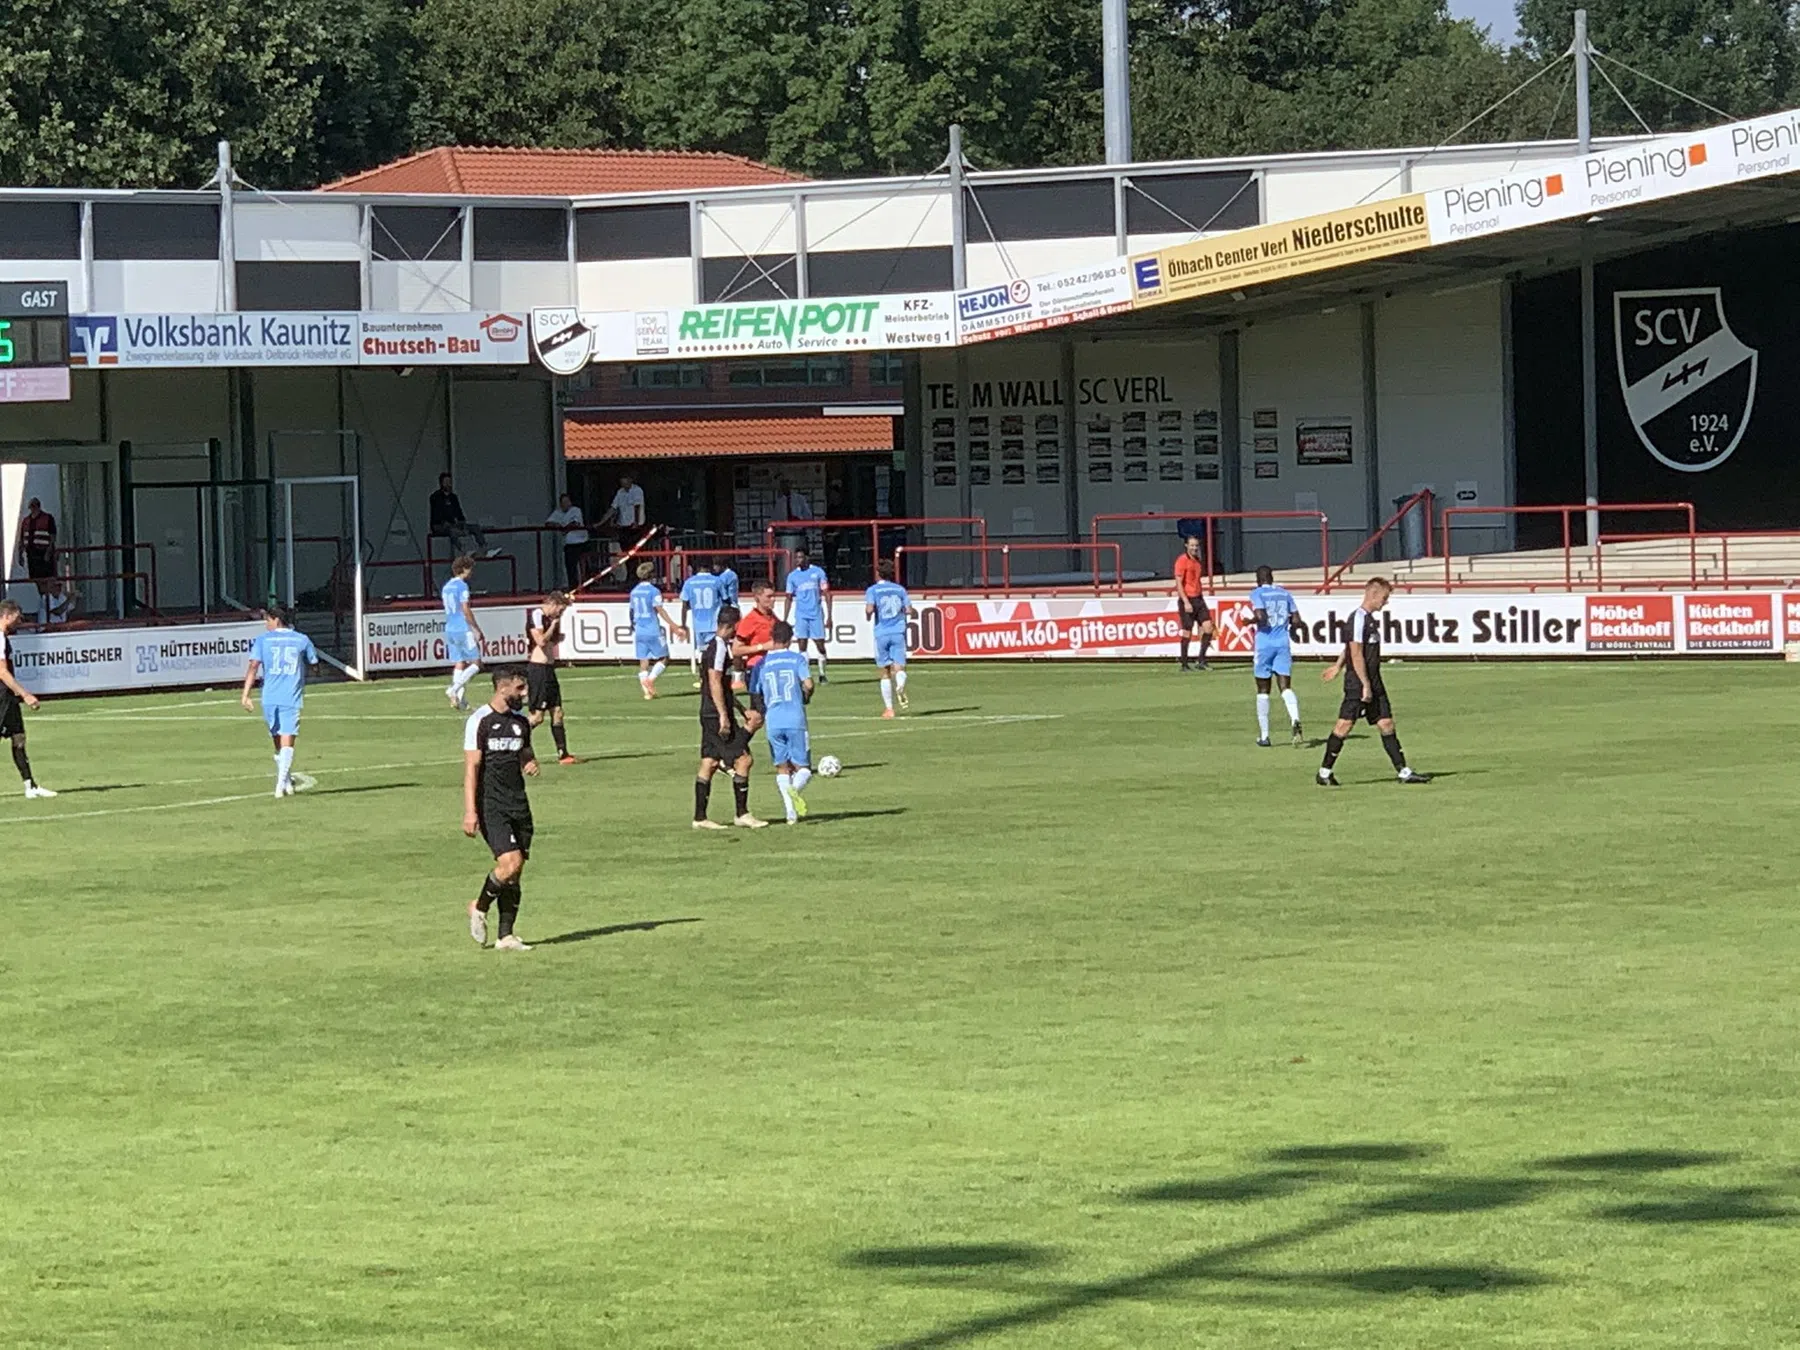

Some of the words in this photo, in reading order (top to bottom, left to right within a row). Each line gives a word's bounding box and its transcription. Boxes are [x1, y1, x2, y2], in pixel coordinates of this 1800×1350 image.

[1732, 116, 1800, 157] Pieni
[1585, 147, 1685, 188] Piening
[1737, 153, 1790, 175] Personal
[1445, 177, 1543, 218] Piening
[1591, 185, 1642, 207] Personal
[1450, 216, 1500, 235] Personal
[1168, 255, 1213, 278] Ölbach
[1215, 245, 1258, 268] Center
[1261, 238, 1288, 258] Verl
[1292, 205, 1425, 251] Niederschulte
[21, 290, 58, 308] GAST
[903, 299, 934, 312] KFZ-
[958, 291, 1010, 313] HEJON
[362, 321, 443, 333] Bauunternehmen
[540, 313, 570, 326] SCV
[884, 311, 950, 324] Meisterbetrieb
[961, 310, 1033, 332] DÄMMSTOFFE
[1634, 308, 1701, 346] SCV
[124, 315, 252, 347] Volksbank
[261, 315, 352, 346] Kaunitz
[885, 331, 941, 347] Westweg
[943, 330, 950, 343] 1
[363, 336, 480, 355] Chutsch-Bau
[757, 338, 783, 350] Auto
[797, 337, 839, 349] Service
[927, 382, 993, 409] TEM
[998, 379, 1063, 407] WALL
[1079, 377, 1108, 405] SC
[1113, 376, 1173, 403] VERL
[1690, 414, 1729, 431] 1924
[1689, 434, 1719, 452] e.V.
[1590, 604, 1644, 620] Möbel
[1689, 603, 1753, 619] Küchen
[1472, 605, 1582, 644] Stiller
[1590, 621, 1671, 637] Beckhoff
[1690, 619, 1769, 636] Beckhoff
[14, 646, 122, 668] ÜTTENHÖLSCHER
[160, 637, 256, 658] HÜTTENHÖLSCH
[368, 639, 426, 664] Meinolf
[269, 645, 298, 675] 15
[765, 670, 795, 703] 17
